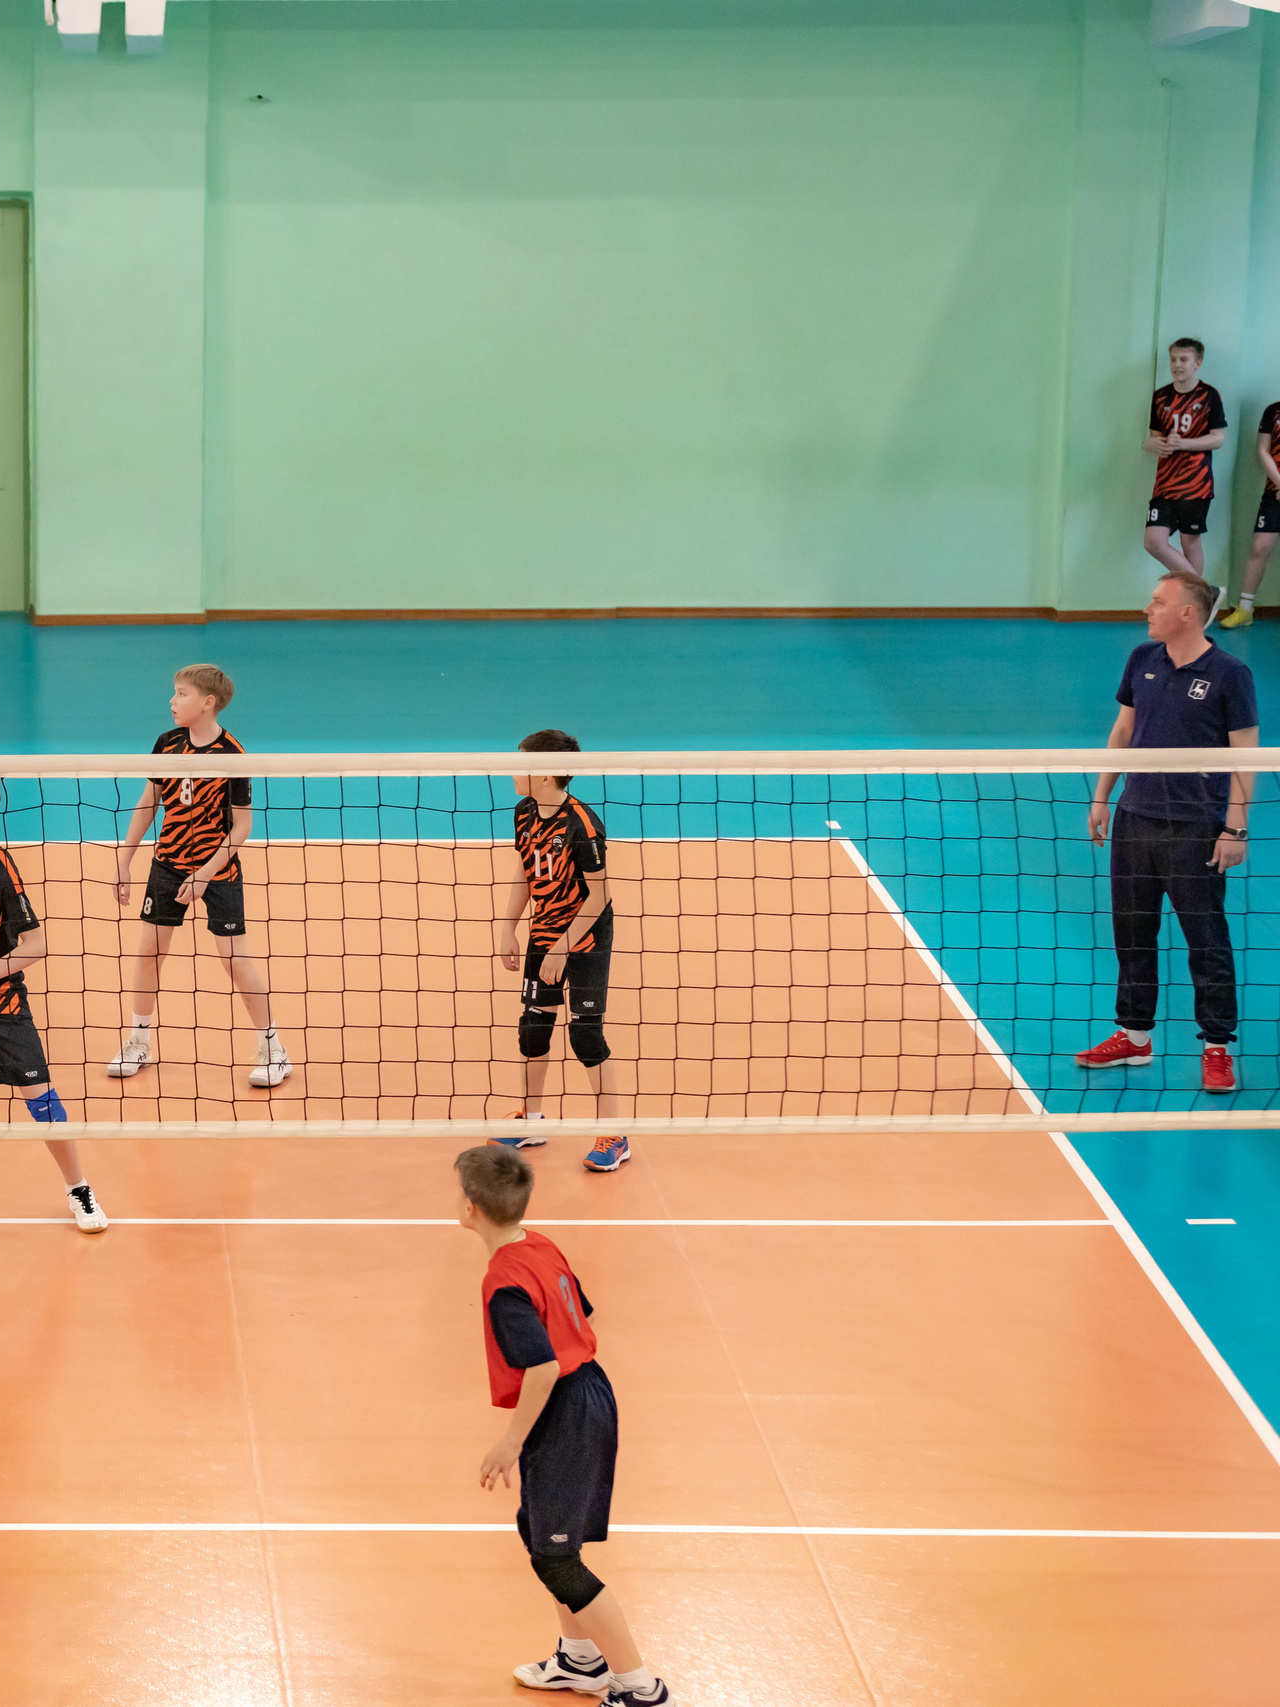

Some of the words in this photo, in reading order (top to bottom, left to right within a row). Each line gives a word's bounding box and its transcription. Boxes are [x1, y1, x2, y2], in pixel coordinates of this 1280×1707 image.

[1172, 413, 1192, 433] 19
[1257, 515, 1265, 529] 5
[180, 778, 195, 805] 8
[533, 849, 553, 881] 11
[143, 896, 153, 915] 8
[522, 978, 538, 999] 11
